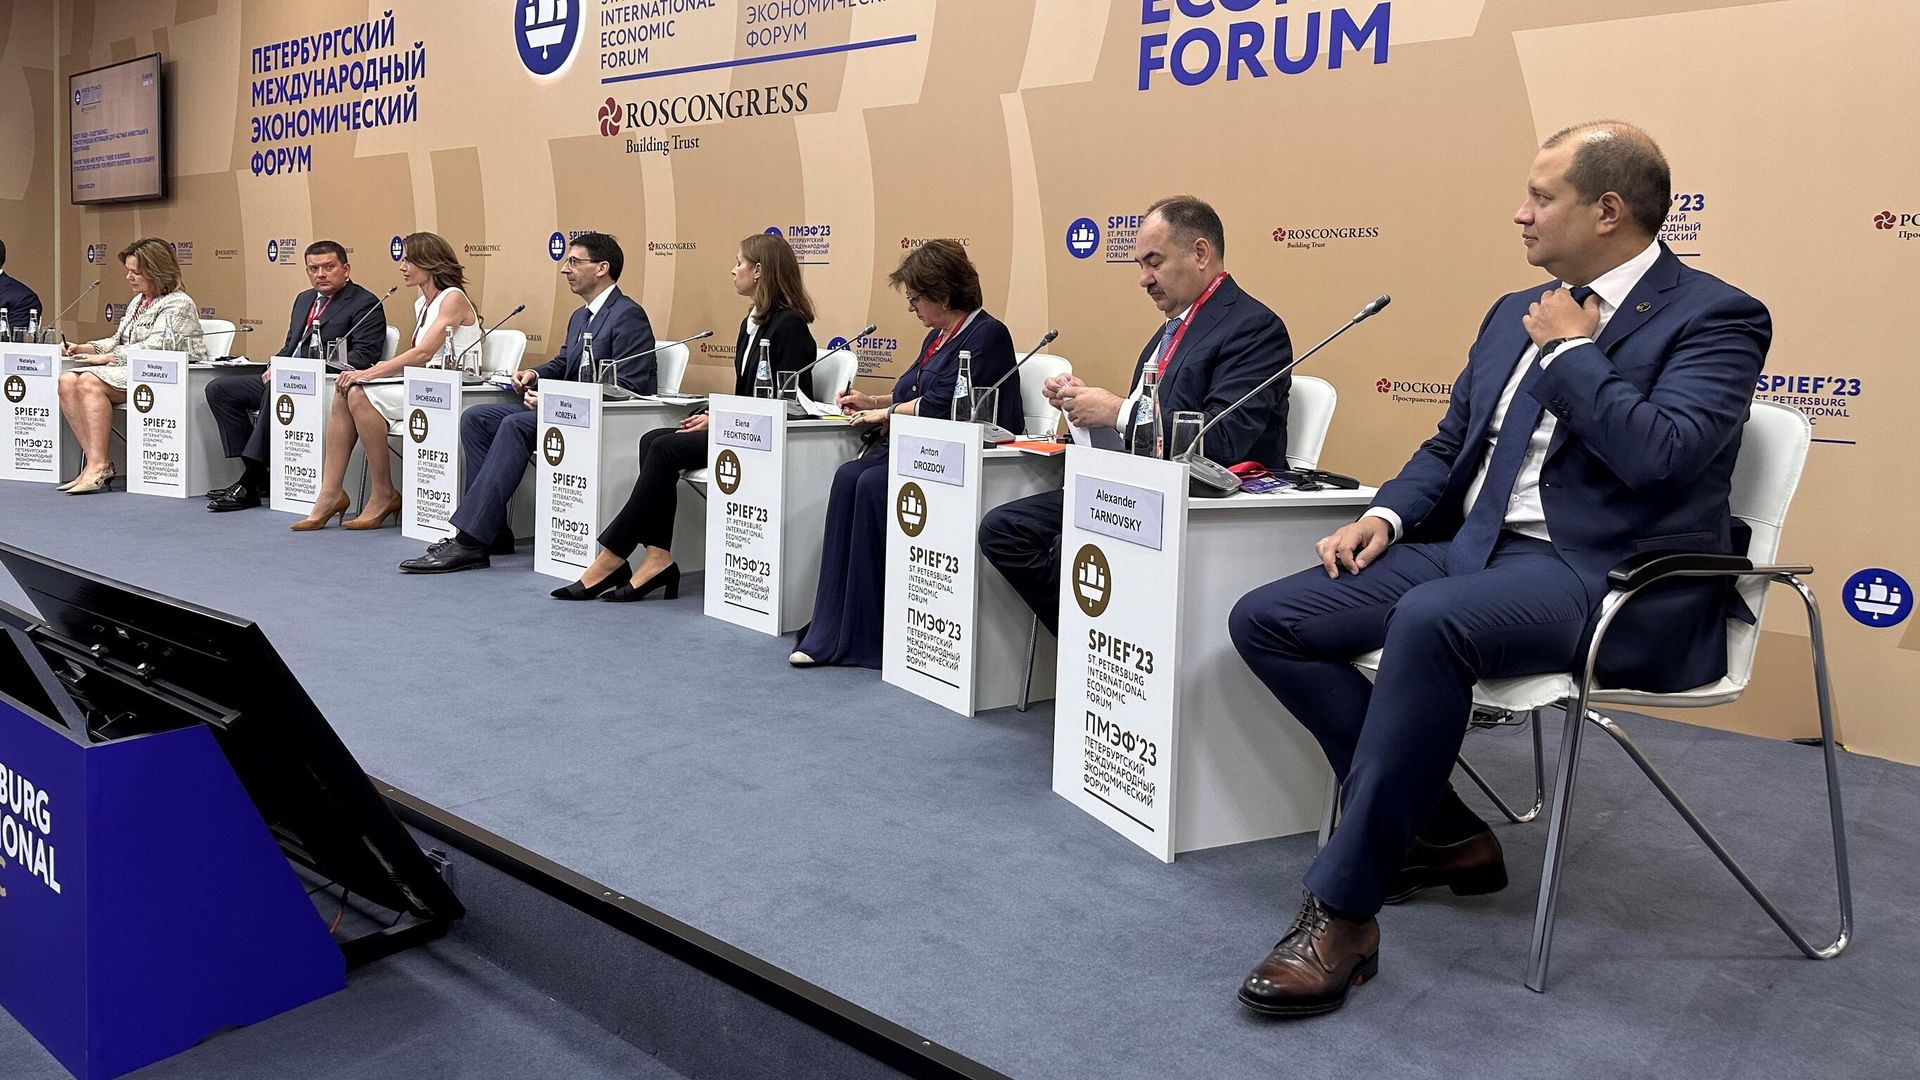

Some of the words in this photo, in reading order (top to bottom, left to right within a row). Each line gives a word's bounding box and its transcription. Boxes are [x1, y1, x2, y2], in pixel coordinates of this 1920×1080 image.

[746, 0, 886, 24] ЭКОНОМИ
[252, 9, 395, 74] ПЕТЕРБУРГСКИЙ
[601, 20, 675, 48] ECONOMIC
[746, 22, 807, 48] ФОРУМ
[1138, 1, 1391, 92] FORUM
[601, 48, 648, 69] FORUM
[252, 41, 425, 107] МЕЖДУНАРОДНЫЙ
[251, 84, 417, 143] ЭКОНОМИЧЕСКИЙ
[626, 82, 808, 128] ROSCONGRESS
[626, 137, 669, 156] Building
[672, 135, 700, 150] Trust
[251, 145, 311, 177] ФОРУМ
[789, 225, 830, 236] ПМЭФ'23
[1108, 215, 1145, 228] SPIEF
[1287, 227, 1379, 239] ROSCONGRESS
[857, 338, 897, 349] SPIEF'23
[1393, 382, 1452, 394] РОСКОН
[1755, 375, 1861, 396] SPIEF'23
[1773, 396, 1846, 406] PETERSBURG
[15, 407, 50, 417] SPIEF'23
[555, 411, 577, 420] KOBZEVA
[143, 418, 176, 429] SPIEF'23
[735, 419, 750, 428] Elena
[15, 438, 53, 449] ПМЭФ'23
[284, 430, 314, 442] SPIEF'23
[143, 451, 179, 462] ПМЭФ'23
[418, 448, 448, 463] SPIEF'23
[920, 446, 939, 457] Anton
[285, 465, 317, 478] ПМЭФ'23
[913, 460, 945, 474] DROZDOV
[553, 472, 587, 489] SPIEF'23
[417, 487, 450, 503] ПМЭФ'23
[1096, 489, 1136, 509] Alexander
[727, 501, 768, 522] SPIEF'23
[1090, 507, 1142, 532] TARNOVSKY
[552, 517, 589, 535] ПМЭФ'23
[726, 525, 763, 539] INTERNATIONAL
[733, 519, 762, 531] PETERSBURG
[725, 540, 742, 549] FORUM
[726, 533, 751, 544] ECONOMIC
[725, 553, 770, 576] ПМЭФ'23
[910, 546, 958, 574] SPIEF'23
[909, 574, 954, 594] INTERNATIONAL
[917, 567, 952, 583] PETERSBURG
[908, 583, 938, 599] ECONOMIC
[908, 592, 927, 605] FORUM
[908, 608, 961, 641] ПМЭФ'23
[907, 626, 952, 649] ПЕТЕРБУРГСКИЙ
[906, 645, 959, 672] ЭКОНОМИЧЕСКИЙ
[907, 636, 960, 662] МЕЖДУНАРОДНЫЙ
[1088, 628, 1153, 674] SPIEF'23
[906, 655, 927, 669] ФОРУМ
[1088, 654, 1098, 666] ST.
[1098, 658, 1144, 686] PETERSBURG
[1087, 665, 1146, 701] INTERNATIONAL
[1087, 678, 1126, 705] ECONOMIC
[1087, 690, 1112, 710] FORUM
[1086, 710, 1157, 767] ПМЭФ'23
[1085, 735, 1145, 777] ПЕТЕРБУРГСКИЙ
[1084, 748, 1155, 797] МЕЖДУНАРОДНЫЙ
[1084, 760, 1153, 808] ЭКОНОМИЧЕСКИЙ
[1084, 773, 1110, 797] ФОРУМ
